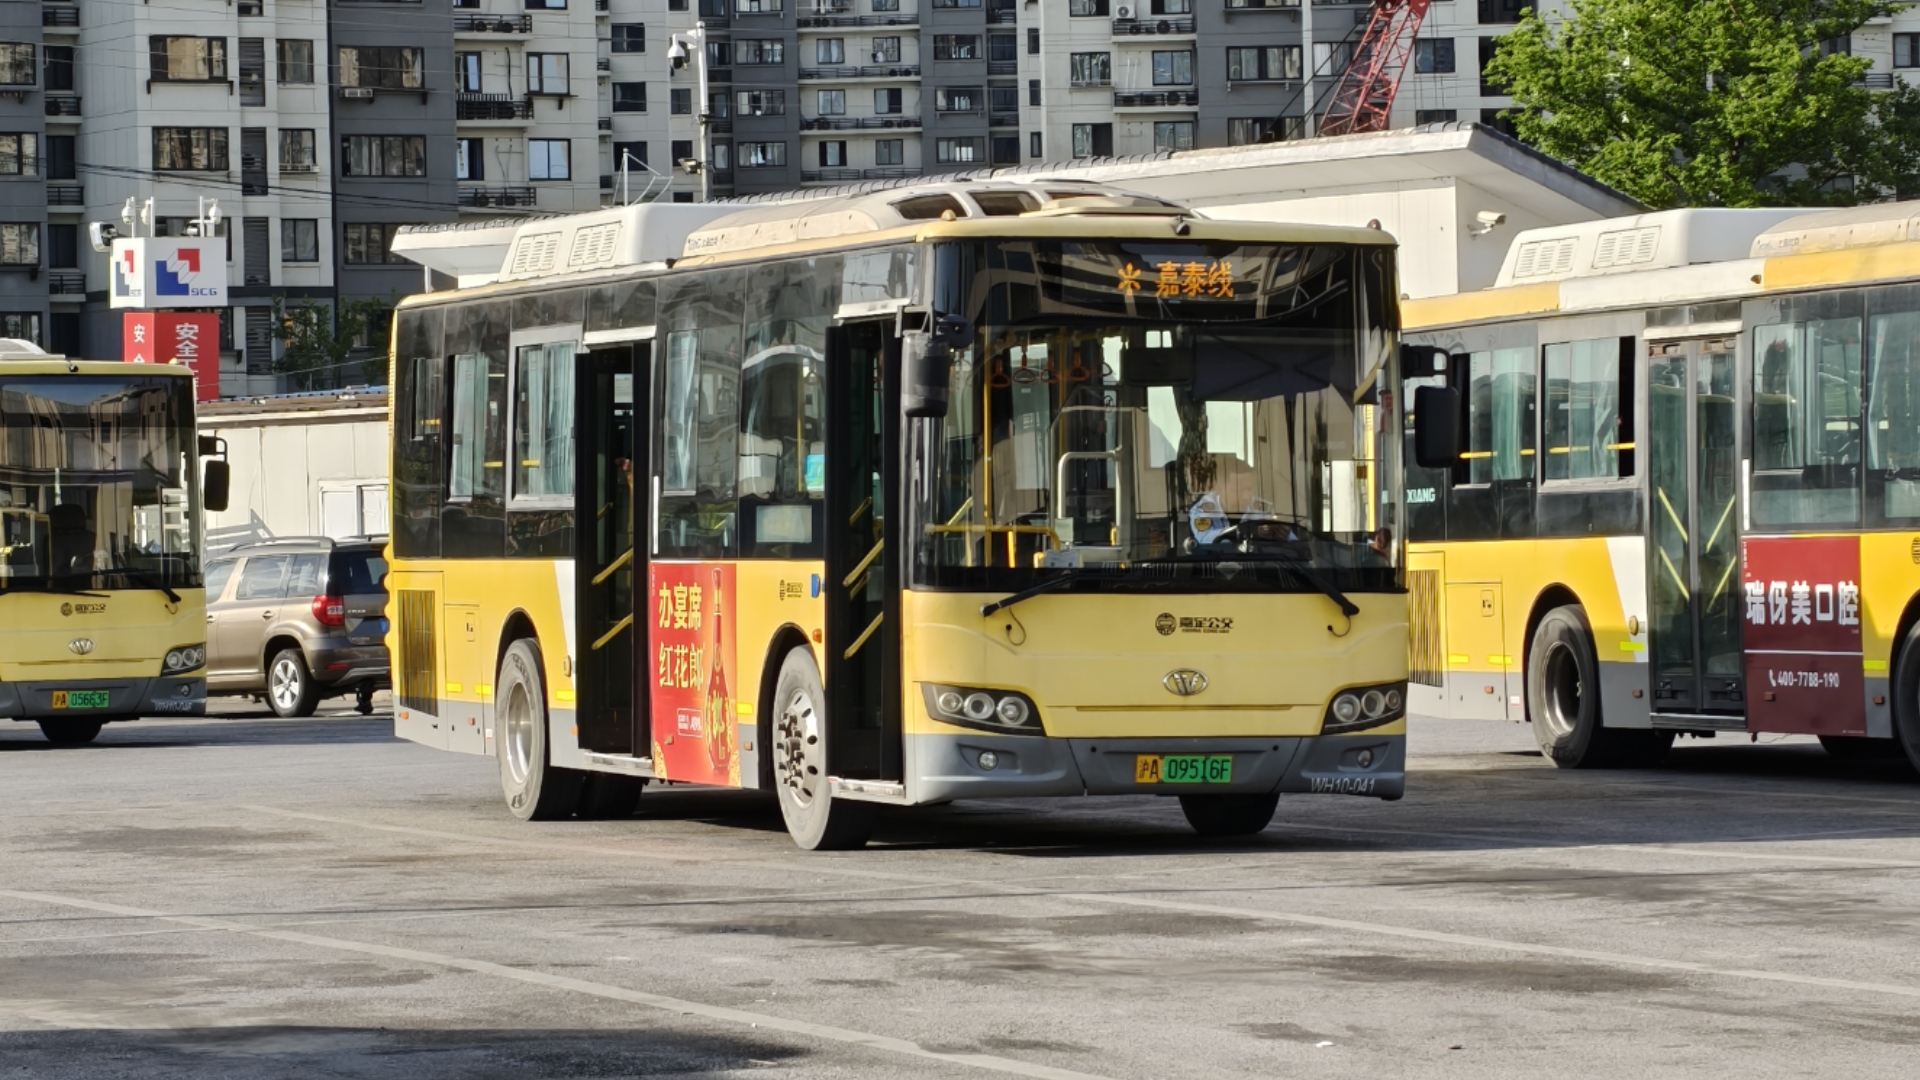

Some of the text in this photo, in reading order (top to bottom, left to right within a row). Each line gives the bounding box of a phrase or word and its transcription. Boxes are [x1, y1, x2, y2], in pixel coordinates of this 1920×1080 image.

[190, 287, 217, 296] SCG
[1155, 260, 1235, 298] 嘉泰线
[658, 582, 703, 631] 办宴席
[1744, 580, 1859, 625] 瑞伢美口腔
[658, 642, 704, 692] 红花郎
[1777, 670, 1840, 688] 400-7788-190
[1311, 777, 1376, 793] WH10-041
